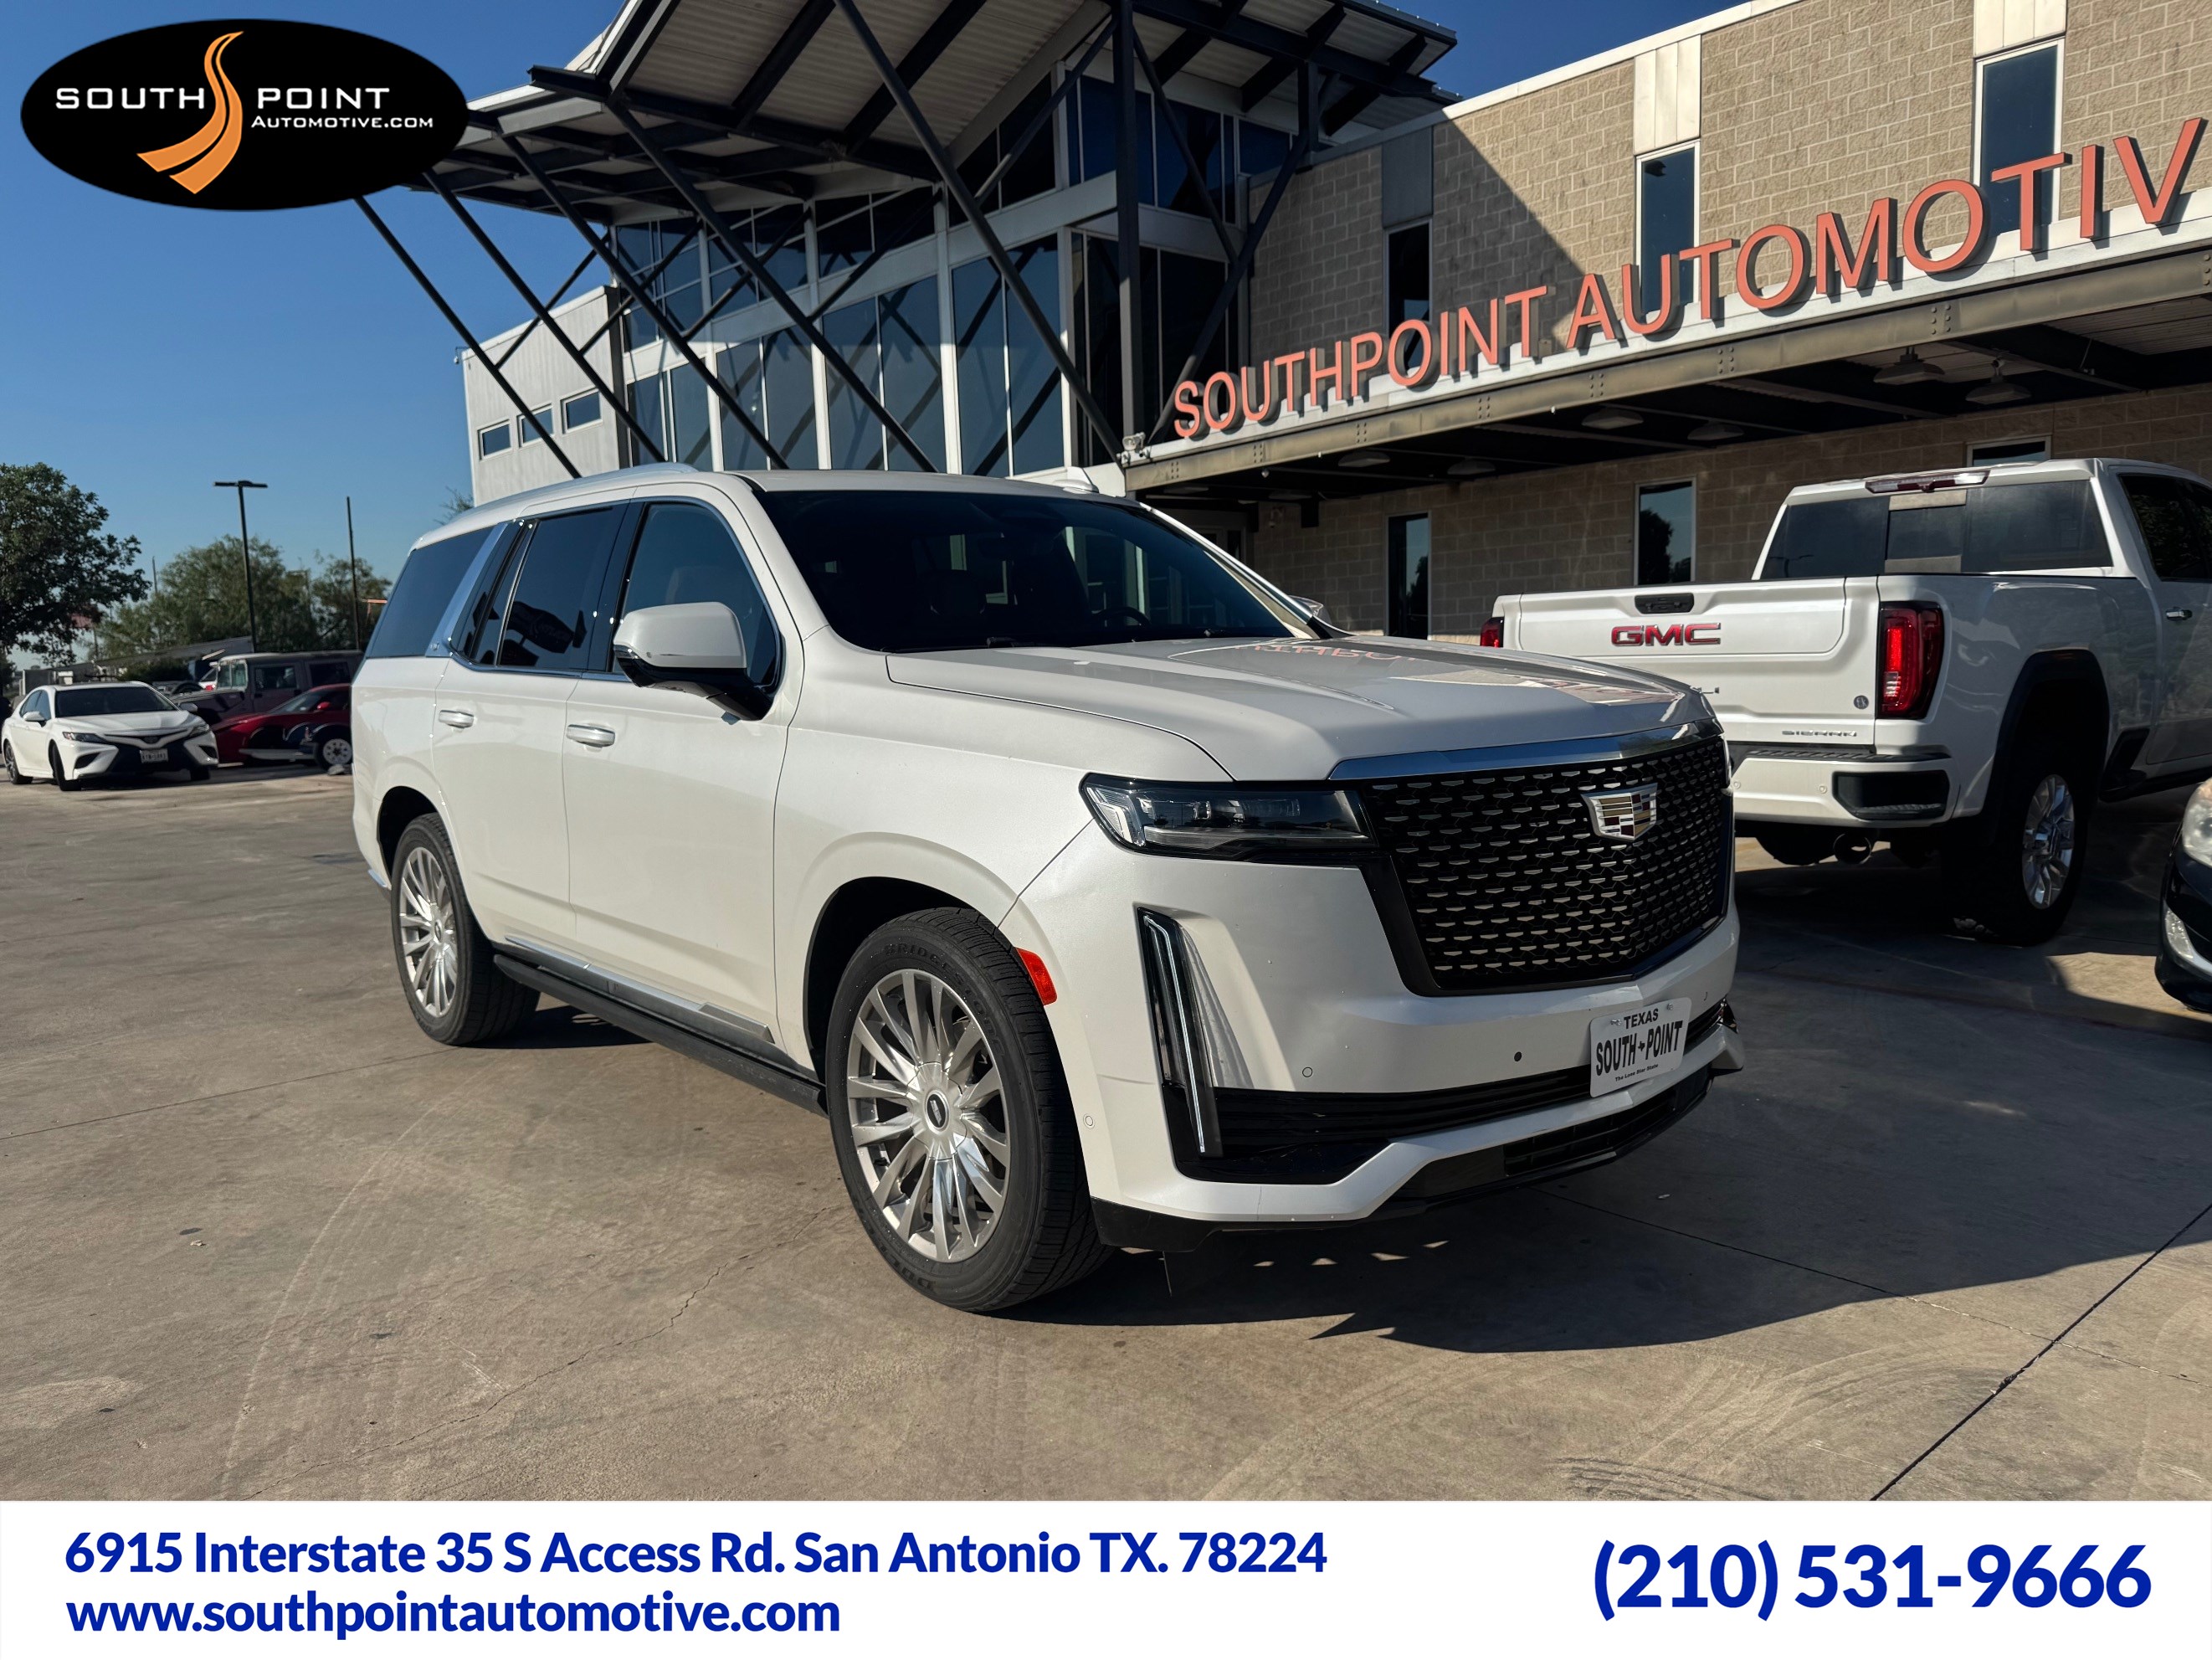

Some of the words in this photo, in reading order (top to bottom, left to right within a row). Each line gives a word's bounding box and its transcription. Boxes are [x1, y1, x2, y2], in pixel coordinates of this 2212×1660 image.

[1173, 285, 1547, 438] SOUTHPOINT
[1565, 117, 2208, 348] AUTOMOTIV
[1611, 623, 1721, 646] GMC
[1624, 1008, 1659, 1030] TEXAS
[1595, 1032, 1638, 1077] SOUTH
[1645, 1020, 1684, 1061] POINT
[1646, 1063, 1659, 1072] State
